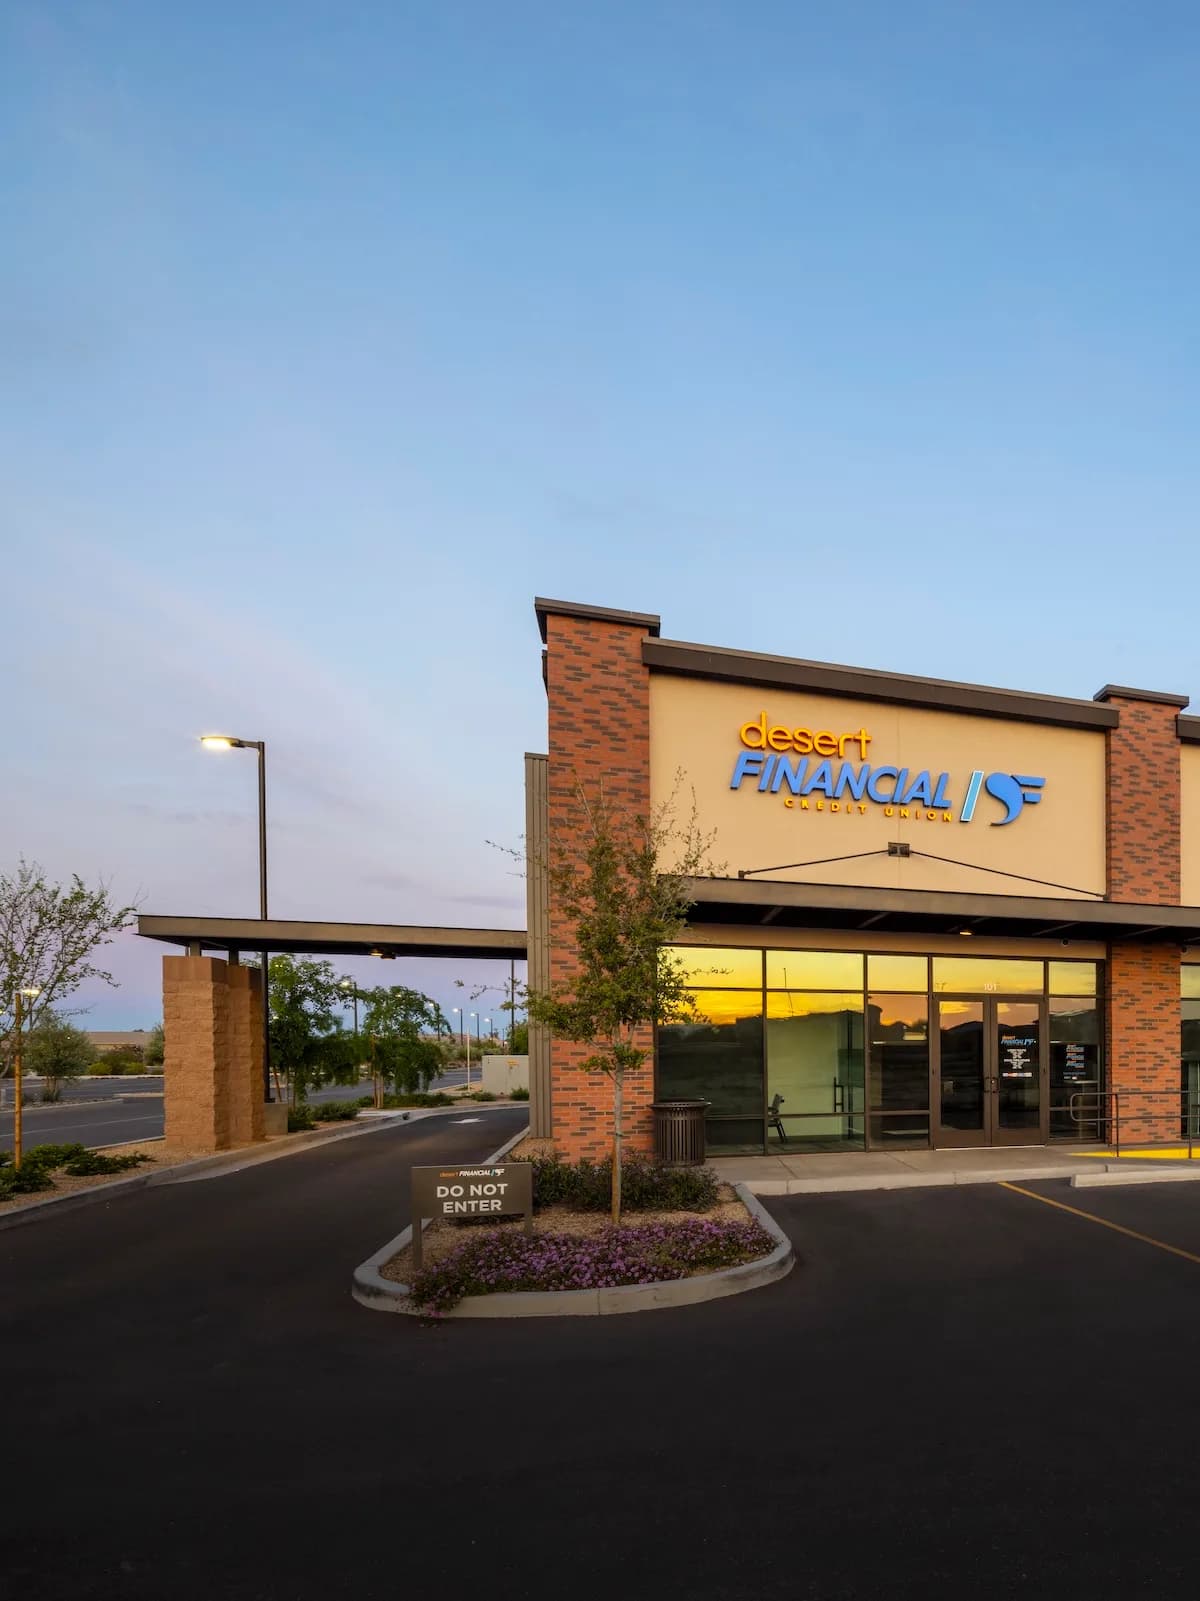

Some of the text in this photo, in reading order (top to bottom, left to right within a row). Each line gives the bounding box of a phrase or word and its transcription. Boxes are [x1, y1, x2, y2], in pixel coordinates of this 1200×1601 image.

[739, 711, 872, 760] desert
[729, 750, 953, 809] FINANCIAL
[784, 798, 953, 823] CREDIT UNION
[459, 1169, 491, 1177] FINANCIAL
[436, 1183, 509, 1198] DO NOT
[443, 1200, 502, 1214] ENTER
